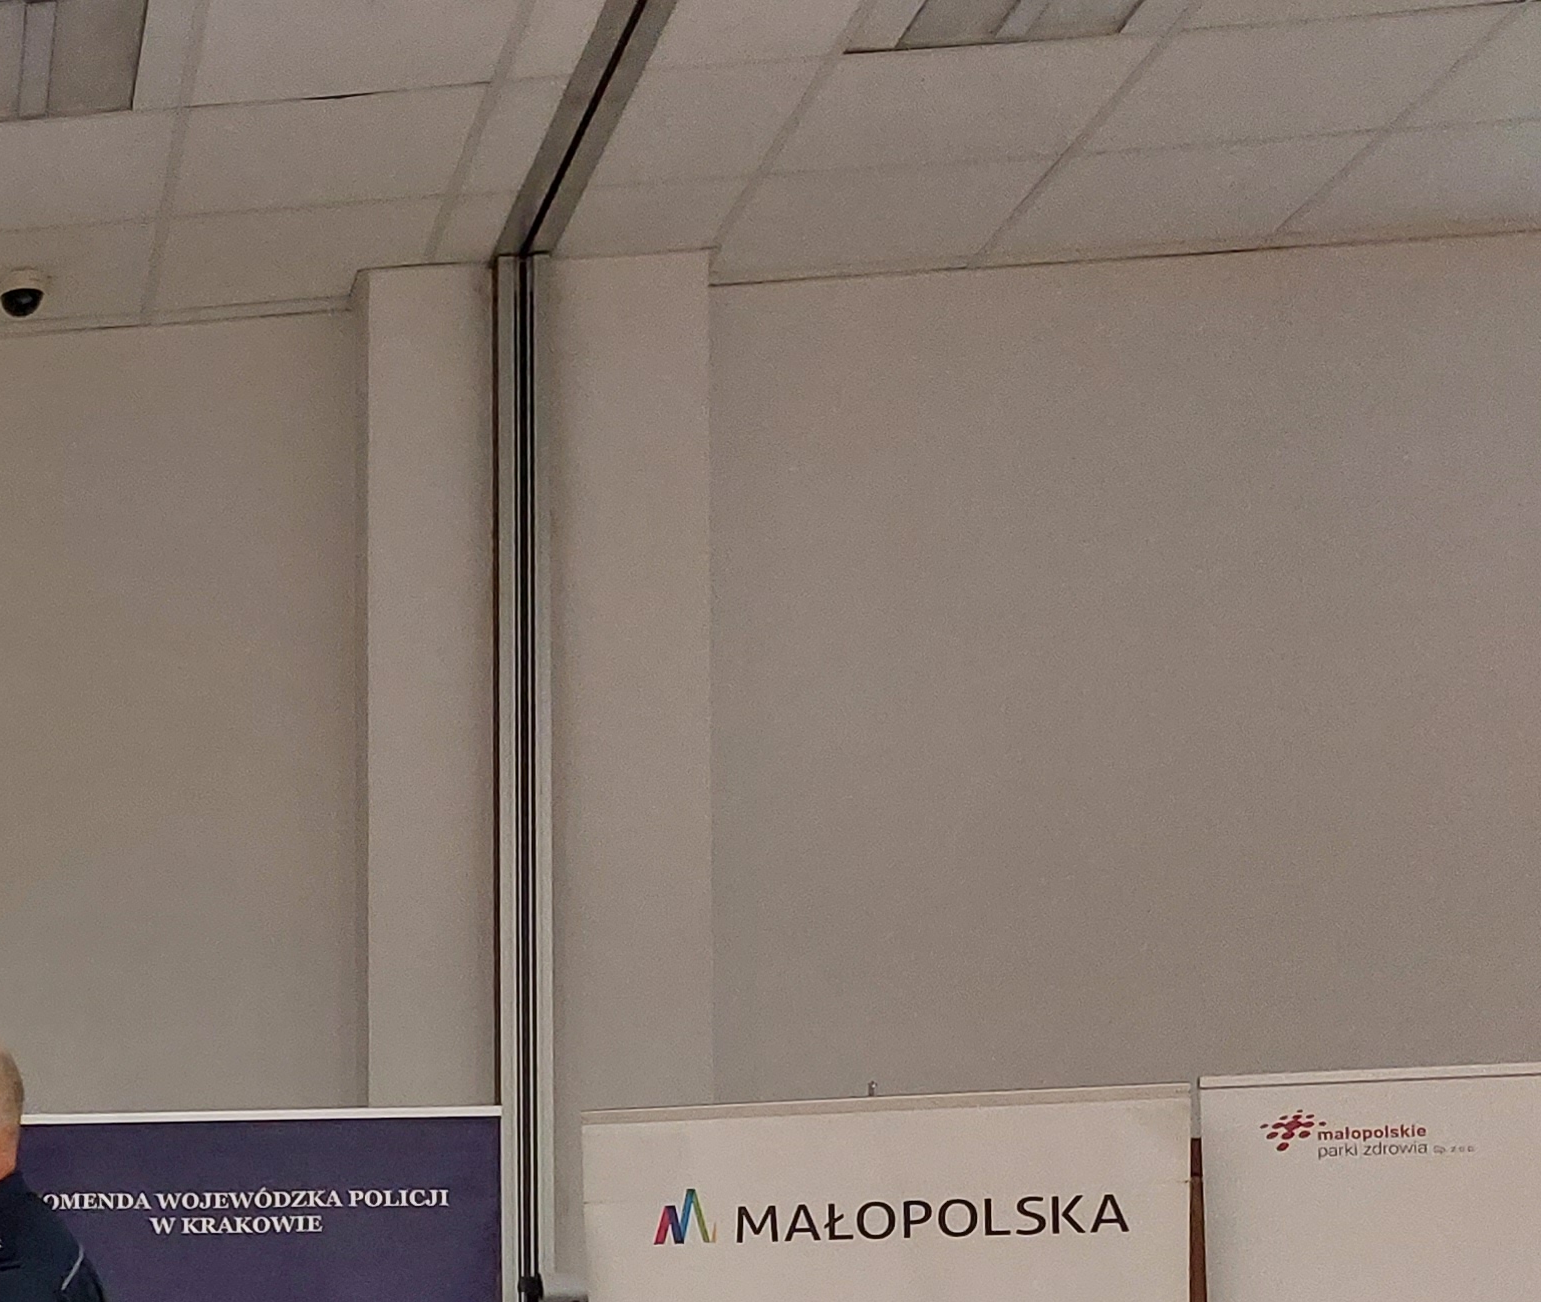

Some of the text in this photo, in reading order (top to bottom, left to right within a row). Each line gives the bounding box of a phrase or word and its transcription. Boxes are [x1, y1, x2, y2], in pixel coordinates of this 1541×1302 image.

[1318, 1143, 1358, 1160] parki
[1363, 1141, 1428, 1157] zdrowia
[43, 1186, 450, 1211] OMENDA WOJEWÓDZKA POLICJI
[149, 1215, 323, 1236] W KRAKOWIE
[735, 1194, 1130, 1244] MAŁOPOLSKA
